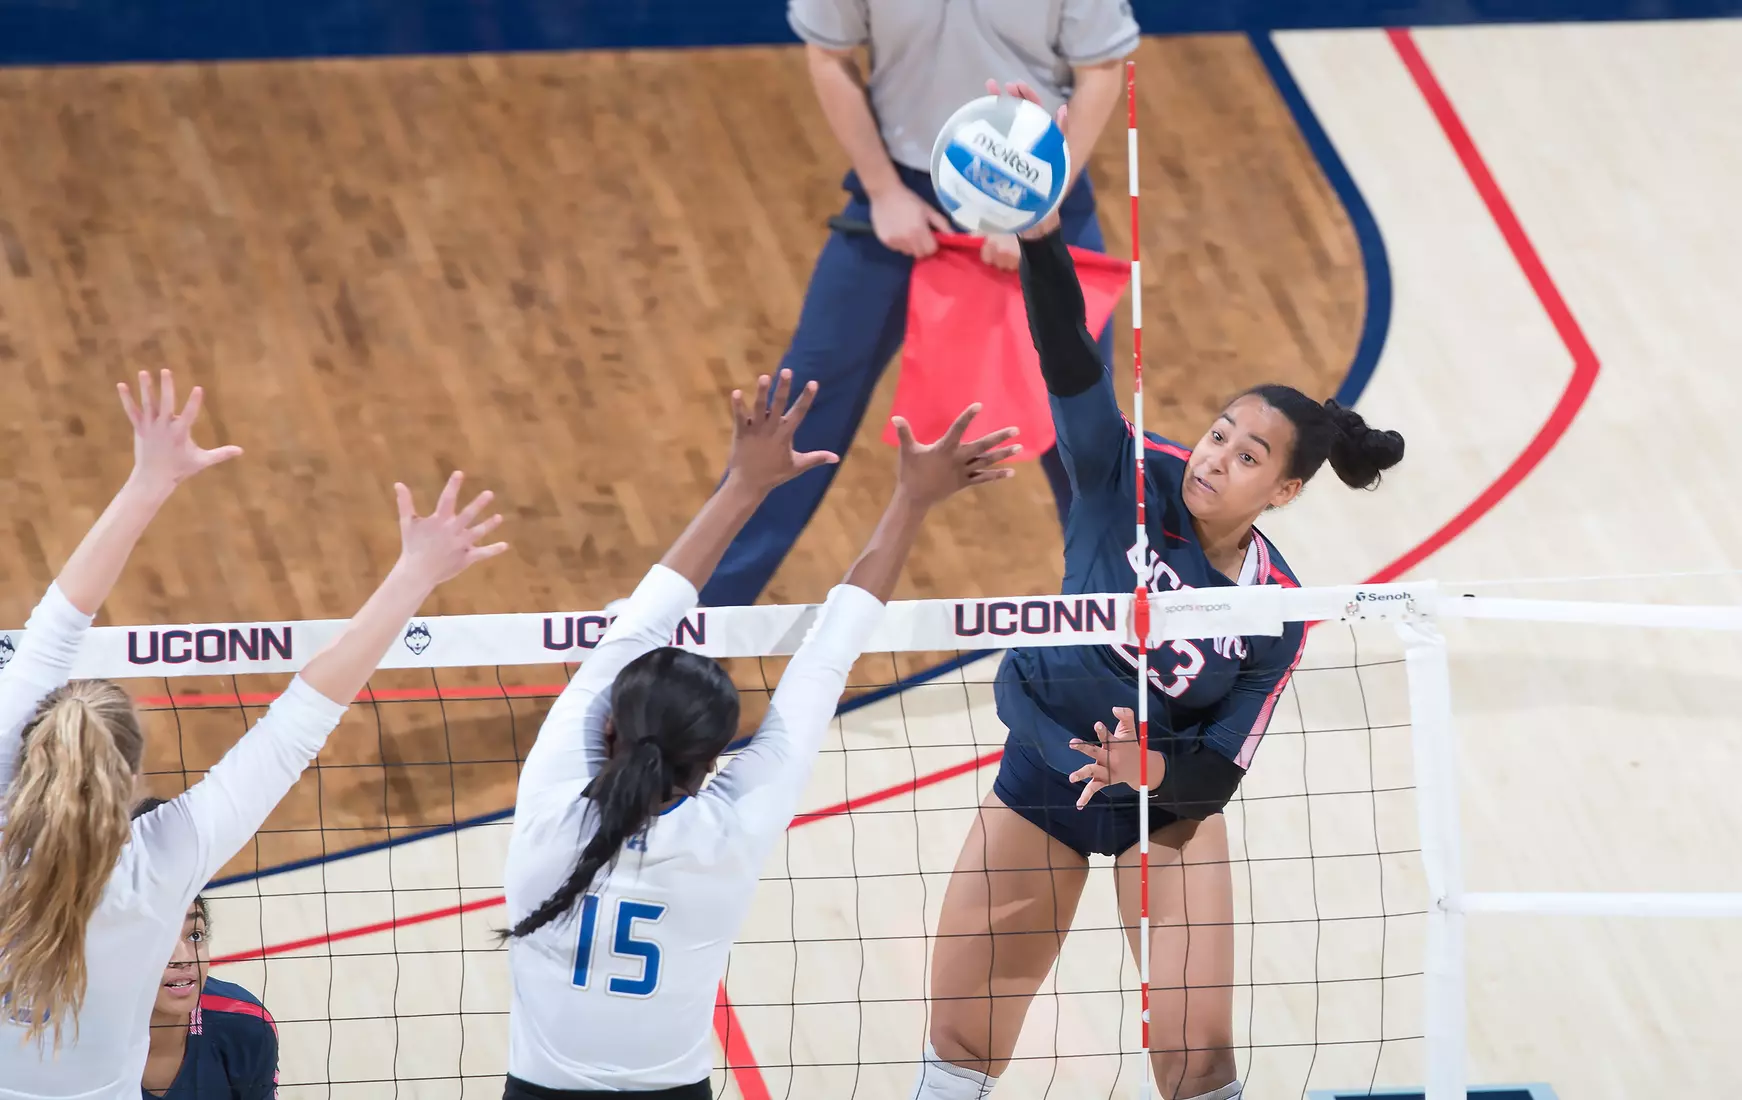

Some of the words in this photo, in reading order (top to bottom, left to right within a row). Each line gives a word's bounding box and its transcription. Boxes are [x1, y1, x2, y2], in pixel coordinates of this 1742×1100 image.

[972, 132, 1039, 183] molten
[1368, 591, 1411, 602] Senoh
[543, 612, 706, 651] UCN
[955, 598, 1115, 637] UCONN
[127, 626, 292, 665] UCONN
[570, 892, 669, 1000] 15
